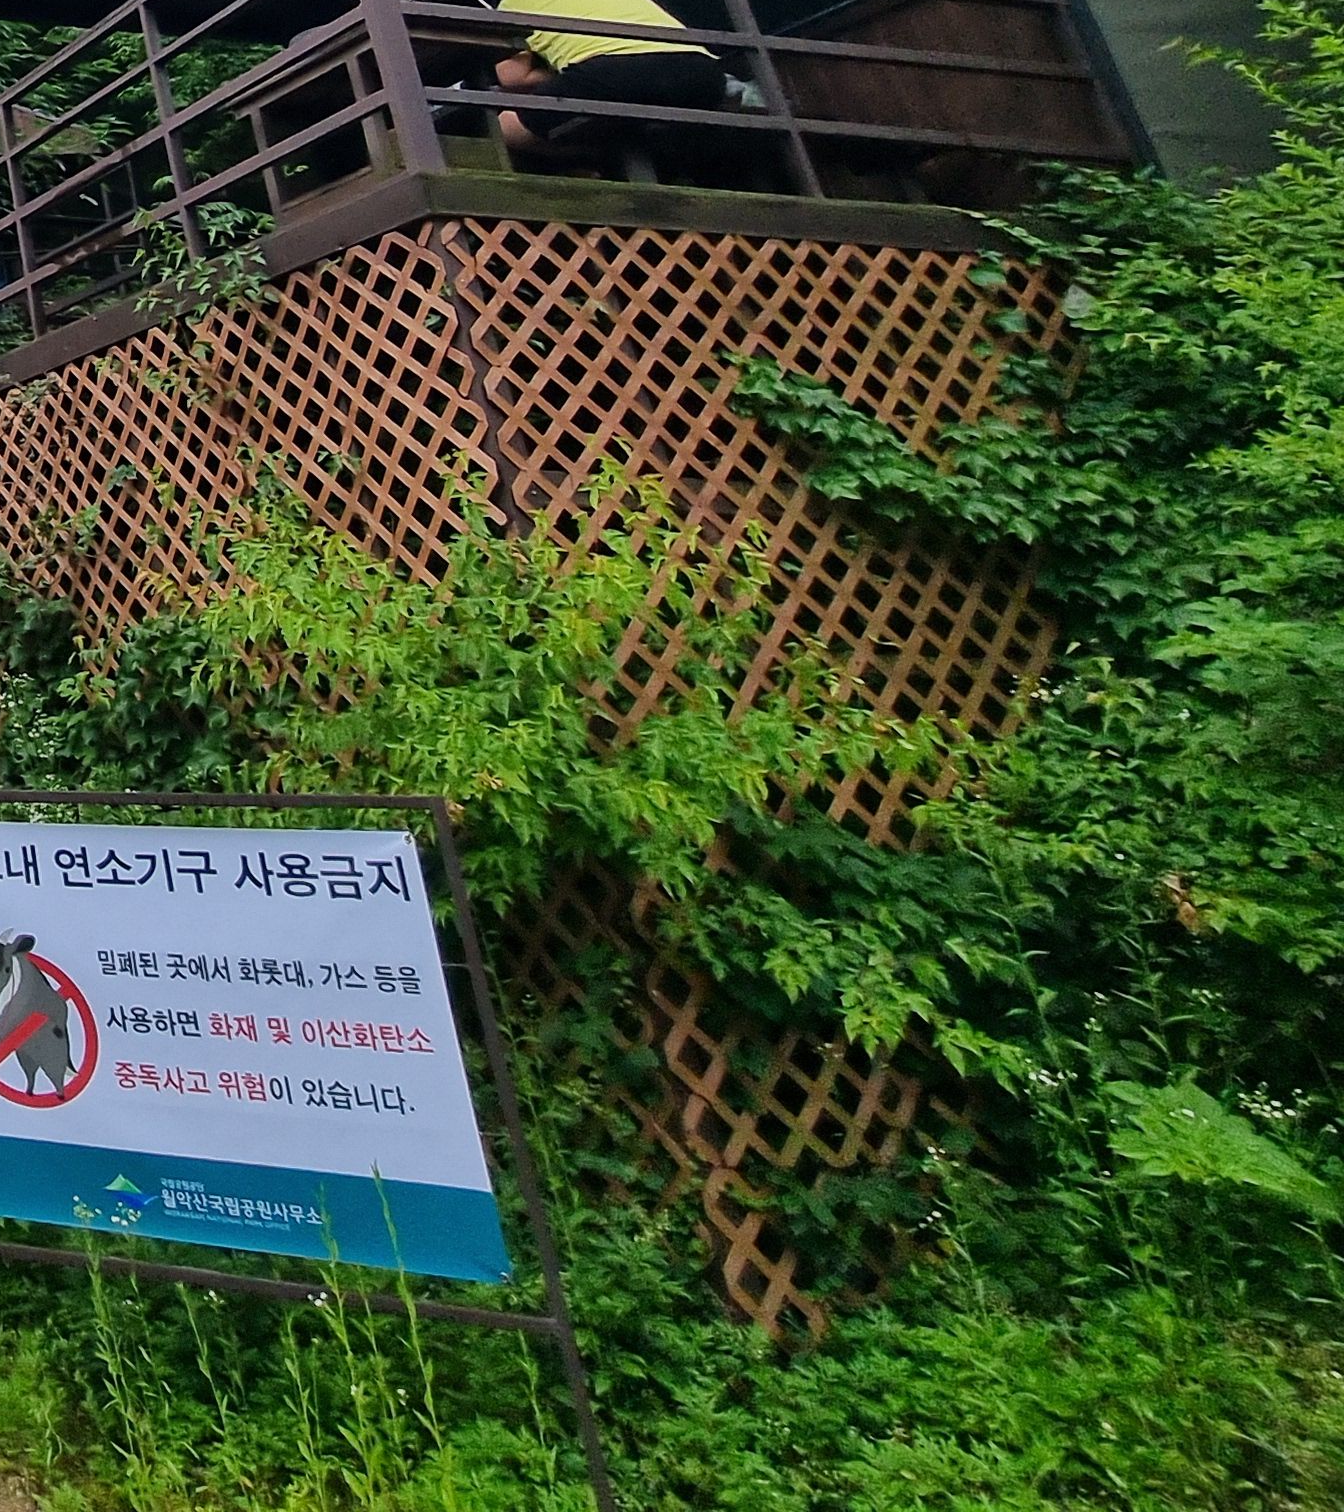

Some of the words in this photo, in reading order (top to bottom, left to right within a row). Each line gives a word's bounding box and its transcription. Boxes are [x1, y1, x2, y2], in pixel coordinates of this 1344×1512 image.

[53, 845, 218, 893] 연소기구
[234, 851, 411, 901] 사용금지
[97, 949, 160, 978] 밀폐된
[166, 953, 232, 983] 곳에서
[237, 957, 313, 989] 화롯대,
[319, 962, 368, 990] 가스
[373, 965, 422, 995] 등을
[107, 1005, 202, 1038] 사용하면
[208, 1013, 258, 1042] 화재
[266, 1017, 293, 1045] 및
[302, 1018, 435, 1054] 이산화탄소
[114, 1061, 212, 1094] 중독사고
[218, 1070, 294, 1105] 위험이
[302, 1078, 416, 1115] 있습니다.
[161, 1188, 324, 1225] 월악산국립공원사무소
